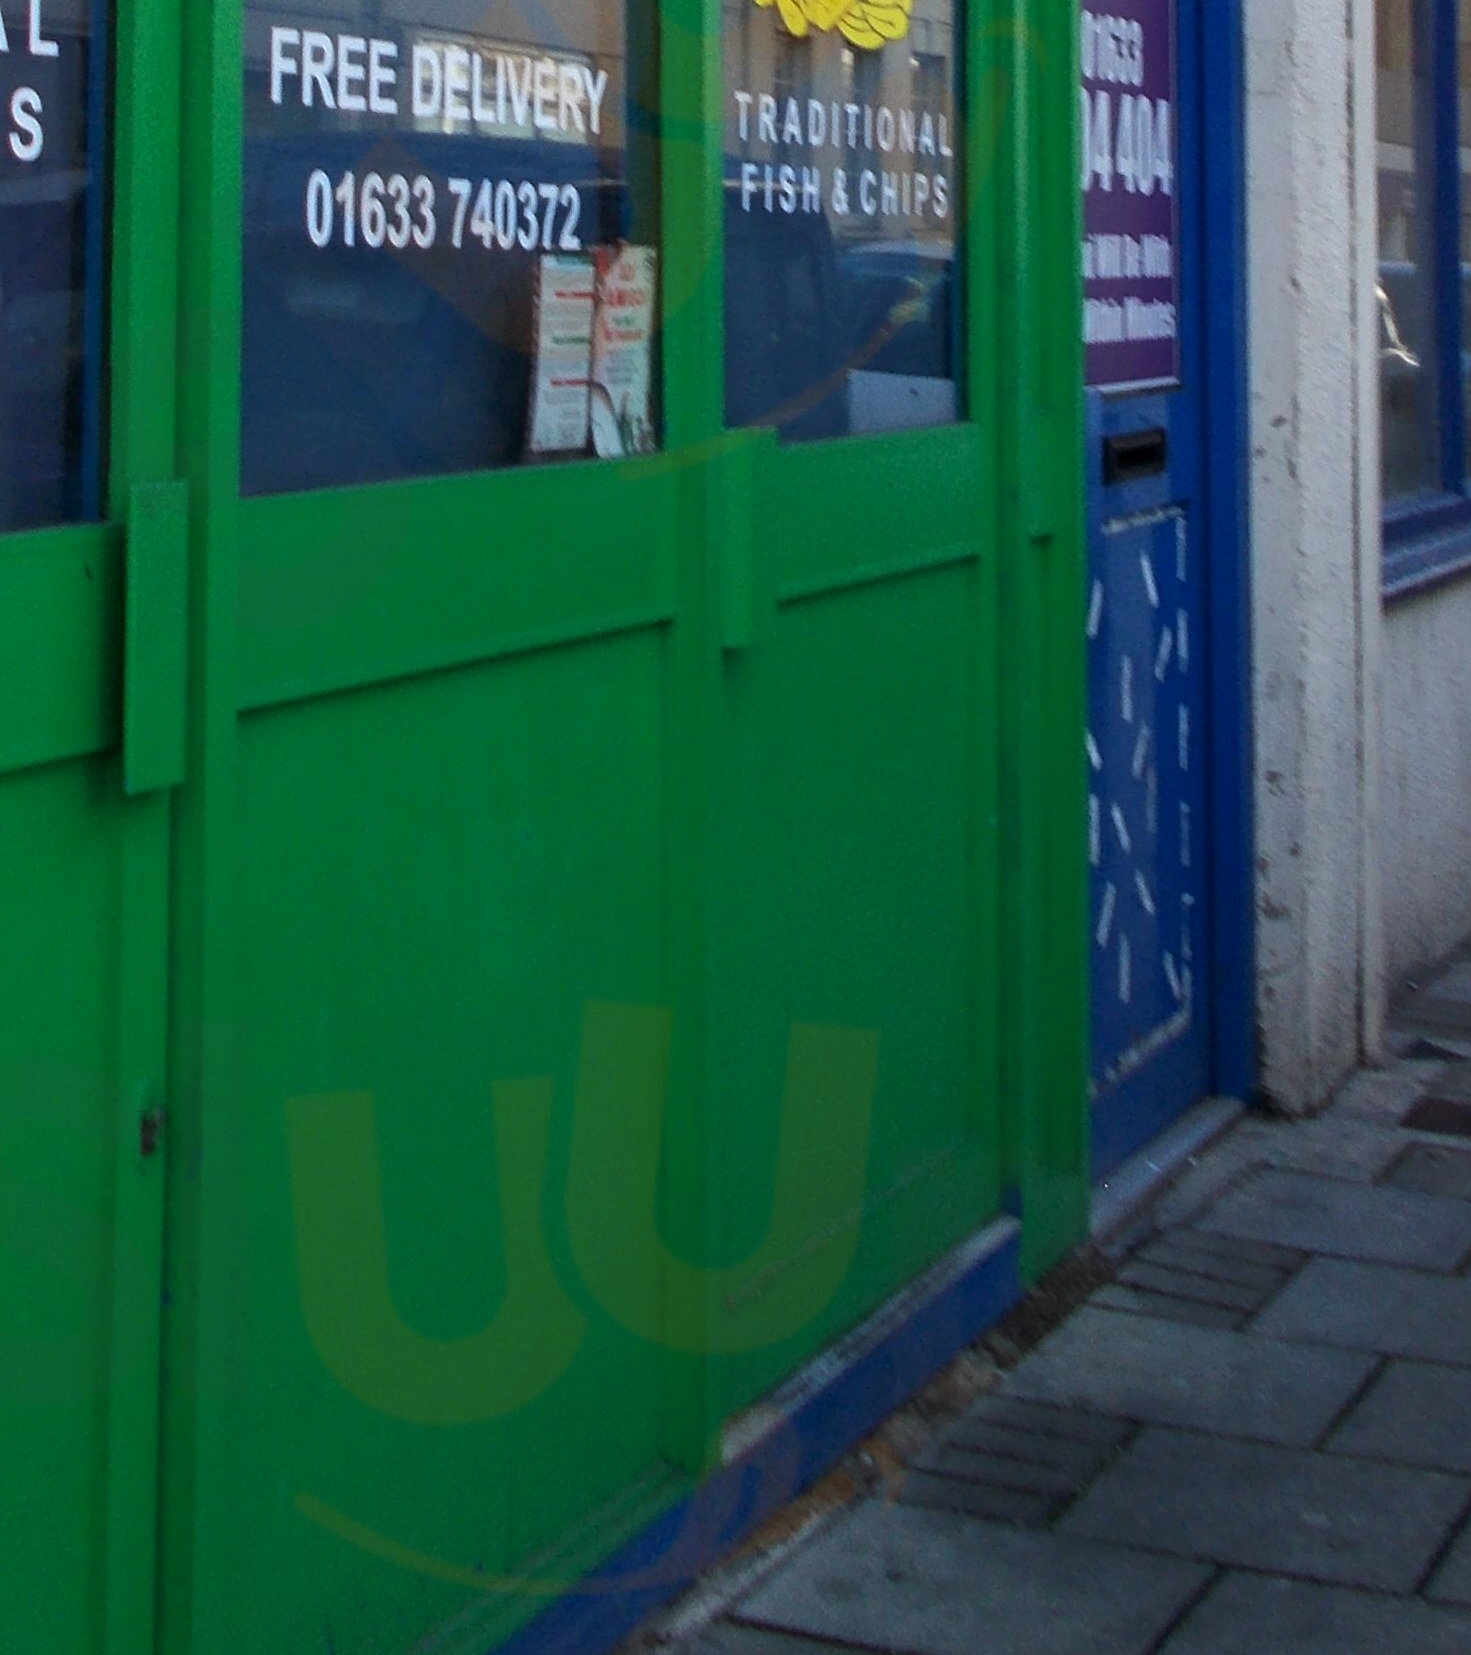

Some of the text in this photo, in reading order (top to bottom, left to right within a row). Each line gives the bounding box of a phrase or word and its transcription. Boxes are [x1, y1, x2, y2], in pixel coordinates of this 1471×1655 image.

[270, 26, 608, 136] FREE DELIVERY
[1080, 9, 1144, 87] 01633
[733, 90, 953, 157] TRADITIONAL
[1116, 93, 1174, 196] 404
[306, 169, 582, 250] 01633 740372
[740, 162, 949, 218] FISH & CHIPS
